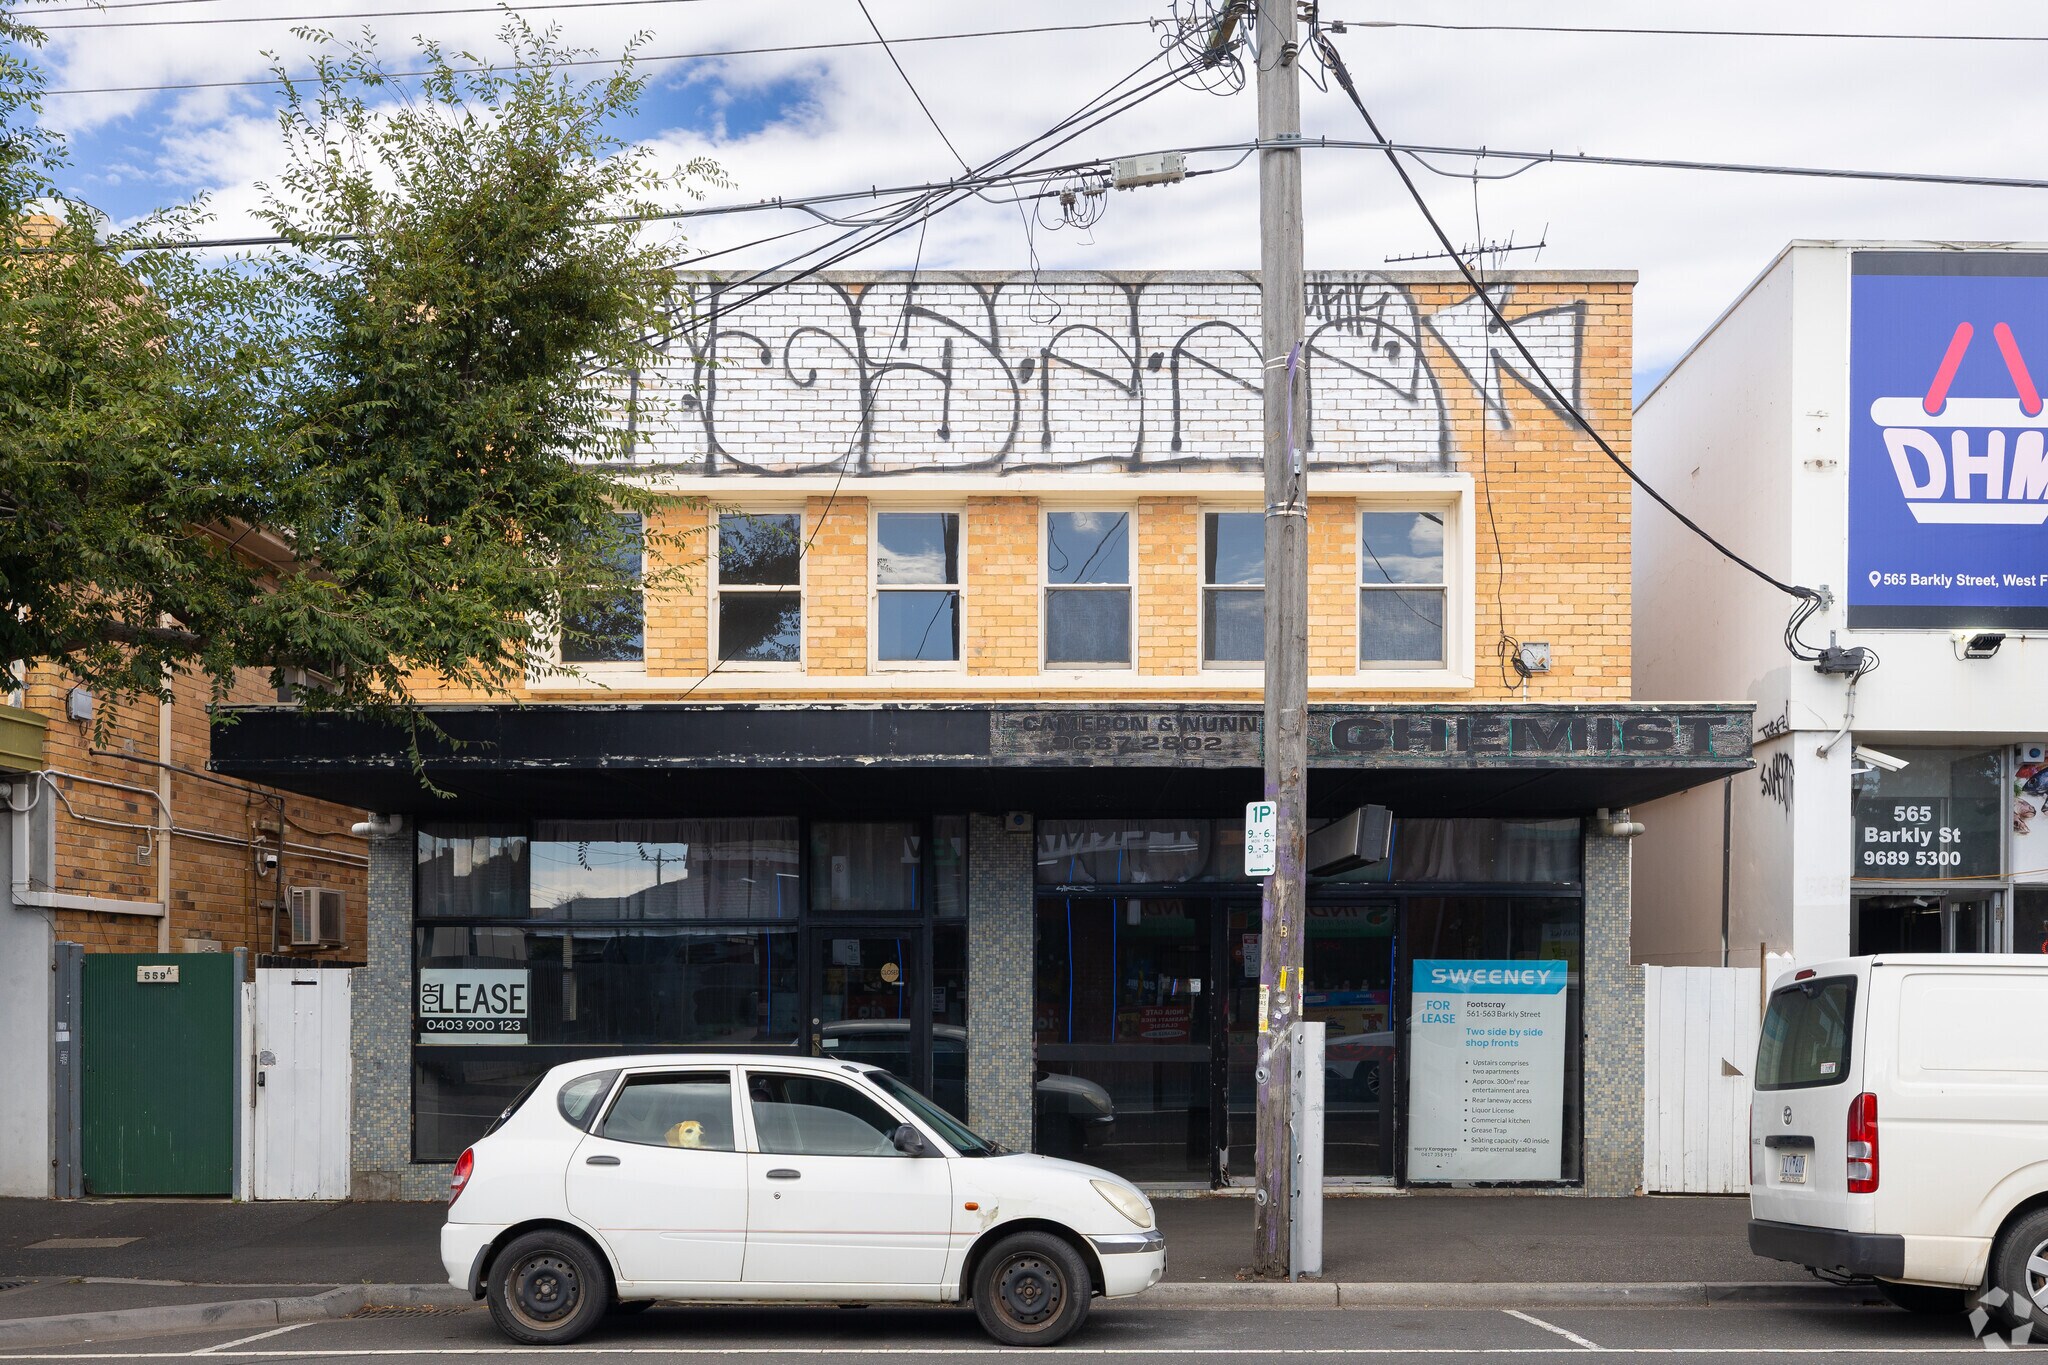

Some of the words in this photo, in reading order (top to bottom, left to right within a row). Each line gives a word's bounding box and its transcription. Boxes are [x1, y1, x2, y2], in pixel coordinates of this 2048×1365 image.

[1882, 427, 2048, 500] DHM
[1883, 573, 1907, 586] 565
[1910, 573, 1952, 589] Barkly
[1956, 574, 1999, 587] Street,
[2003, 574, 2036, 586] West
[1022, 715, 1149, 732] CAMERON
[1157, 715, 1175, 732] &
[1182, 715, 1258, 732] NUNN
[1332, 717, 1729, 752] CHEMIST
[1253, 805, 1271, 823] 1P
[1893, 805, 1932, 822] 565
[1864, 826, 1933, 847] Barkly
[1939, 826, 1961, 843] St
[1863, 851, 1909, 866] 9689
[1915, 851, 1961, 866] 5300
[1431, 968, 1551, 985] SWEENEY
[422, 983, 439, 1013] FOR
[439, 983, 526, 1014] LEASE
[1426, 1000, 1450, 1010] FOR
[1466, 1000, 1506, 1010] Footscray
[1421, 1013, 1456, 1024] LEASE
[1466, 1010, 1496, 1018] 561-563
[1497, 1010, 1518, 1018] Barkly
[1519, 1010, 1541, 1018] Street
[426, 1020, 463, 1031] 0403
[466, 1020, 494, 1031] 900
[498, 1020, 521, 1031] 123
[1466, 1028, 1485, 1036] Two
[1487, 1028, 1506, 1036] side
[1509, 1028, 1520, 1038] by
[1523, 1028, 1543, 1037] side
[1465, 1038, 1489, 1049] shop
[1491, 1039, 1519, 1047] fronts
[1472, 1060, 1498, 1068] Upstairs
[1472, 1078, 1495, 1086] Approx.
[1486, 1097, 1512, 1105] laneway
[1494, 1127, 1507, 1135] Trap
[1494, 1137, 1518, 1145] capacity
[1471, 1146, 1489, 1154] ample
